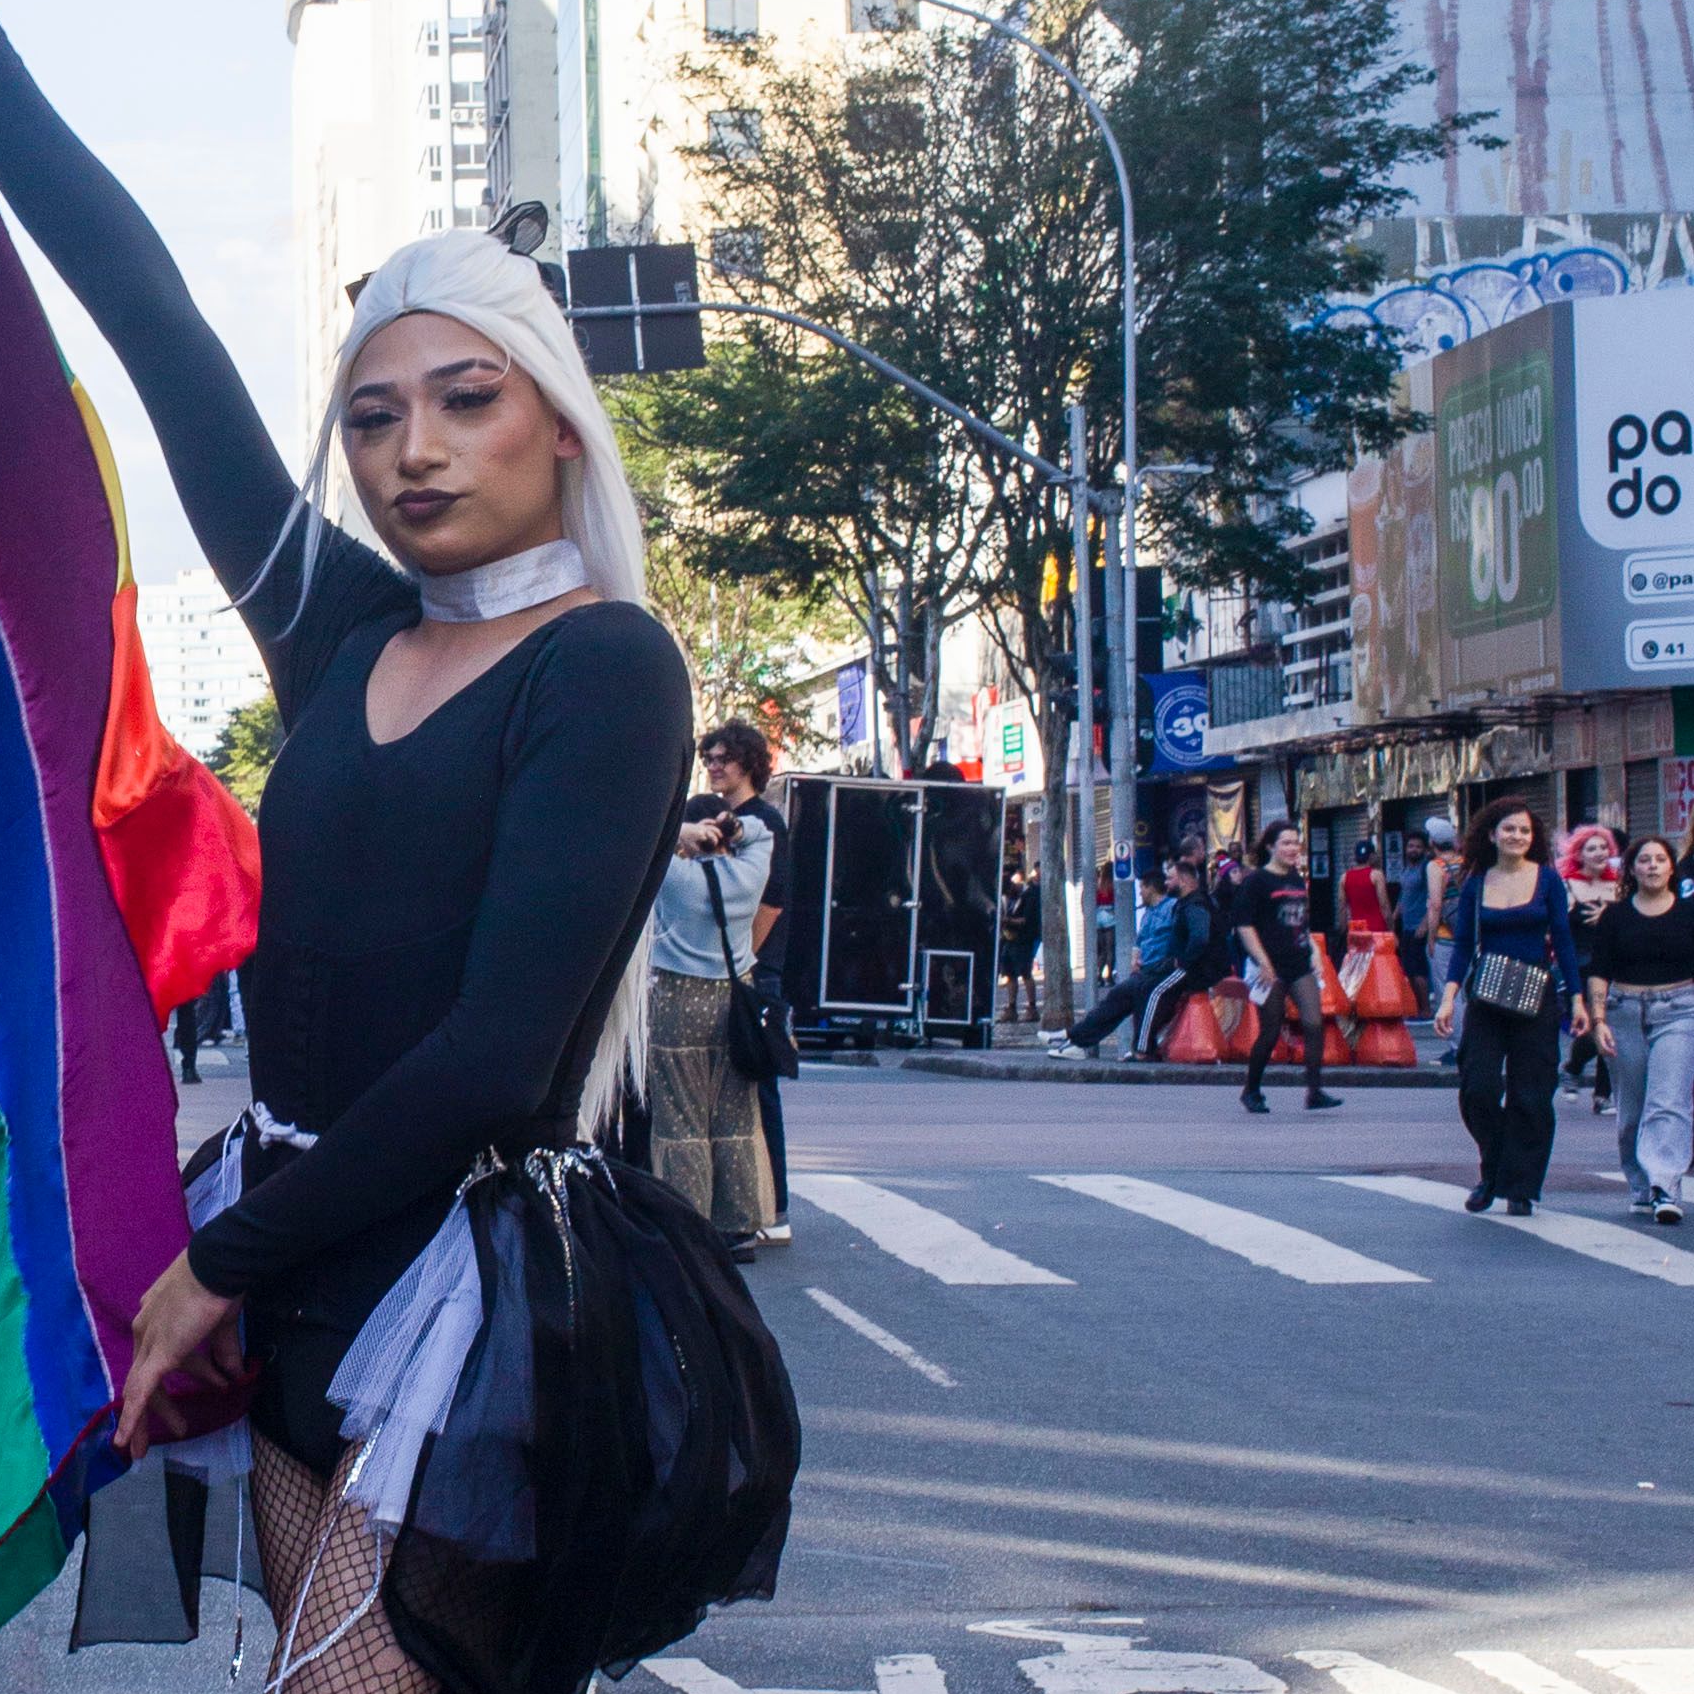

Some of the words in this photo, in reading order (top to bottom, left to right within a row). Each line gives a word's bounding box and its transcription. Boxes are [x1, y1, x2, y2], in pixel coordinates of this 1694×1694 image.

[1449, 404, 1493, 478] PREÇO
[1496, 385, 1542, 459] ÚNICO
[1608, 410, 1693, 474] pa
[1608, 467, 1682, 519] do
[1664, 642, 1685, 656] 41
